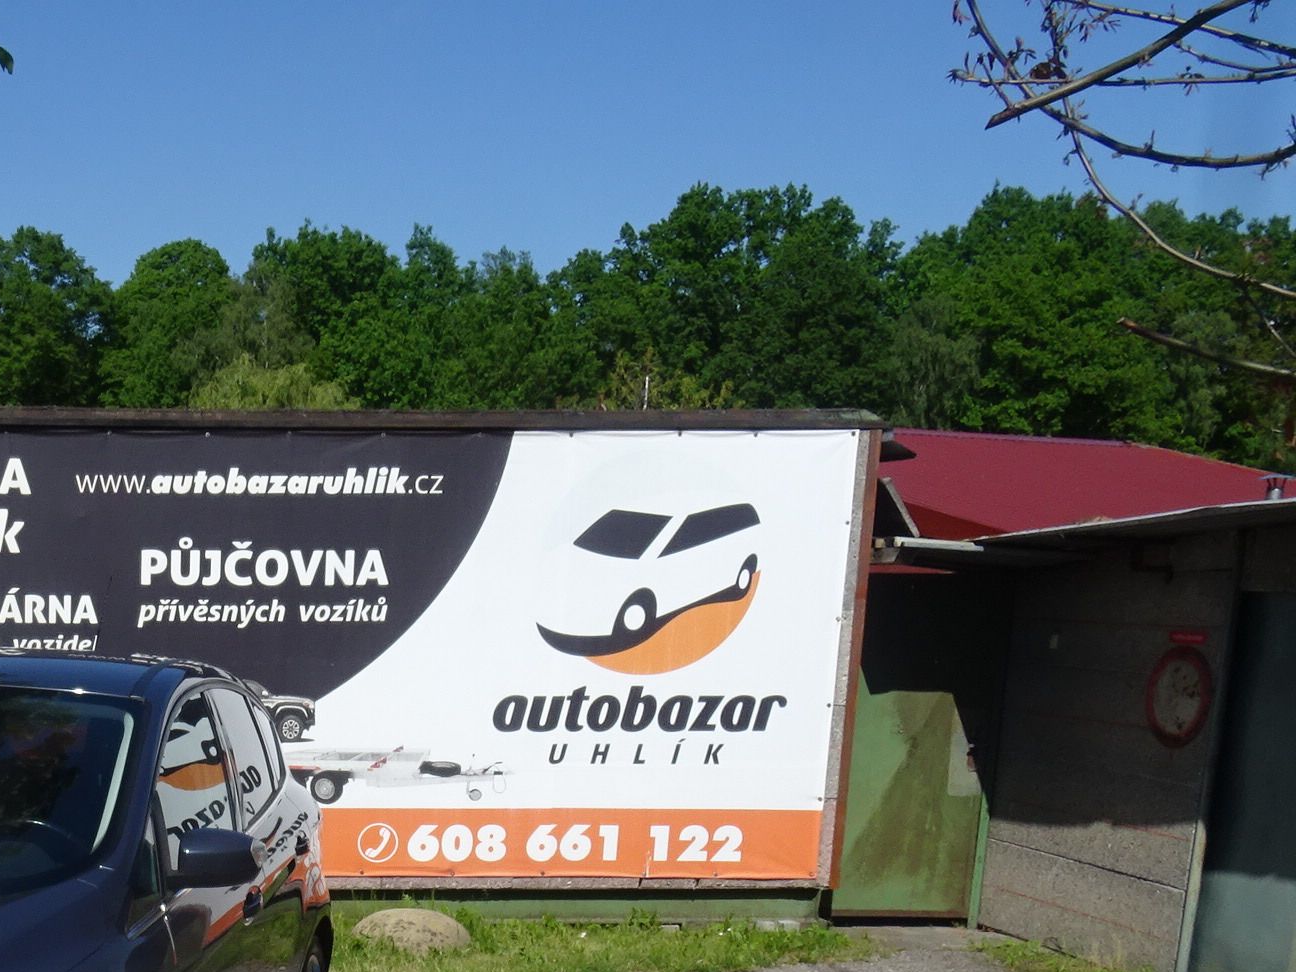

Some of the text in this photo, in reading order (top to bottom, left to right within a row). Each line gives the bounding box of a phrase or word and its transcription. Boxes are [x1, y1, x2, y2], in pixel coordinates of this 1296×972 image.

[75, 466, 444, 495] www.autobazaruhlik.cz
[140, 536, 390, 587] PŮJČOVNA
[137, 596, 389, 629] přívěsných vozíků
[492, 685, 788, 733] autobazar
[548, 738, 726, 765] UHLÍK
[406, 823, 744, 863] 608 661 122
